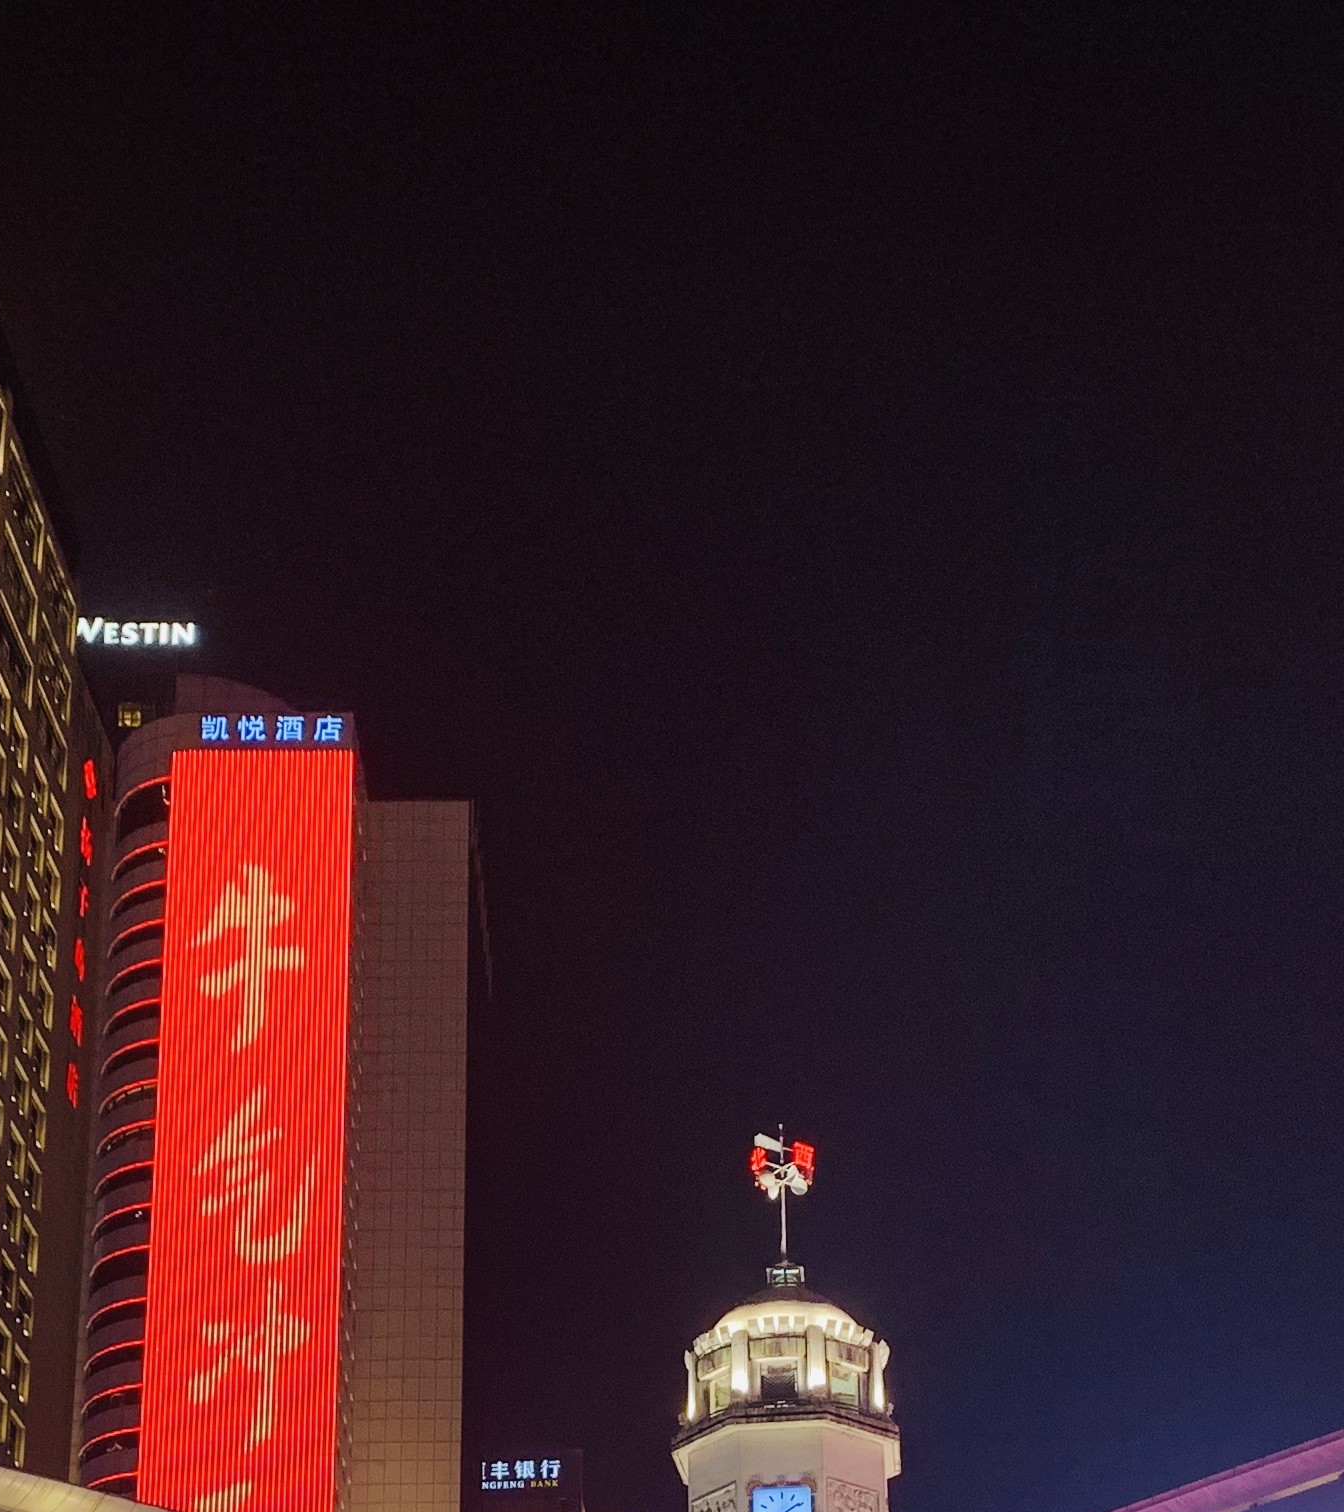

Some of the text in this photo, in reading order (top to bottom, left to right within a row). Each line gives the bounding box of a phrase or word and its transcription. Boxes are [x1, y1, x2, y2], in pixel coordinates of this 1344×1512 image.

[201, 714, 343, 742] 凯悦酒店
[482, 1459, 561, 1481] 丰银行
[530, 1479, 559, 1488] BANK
